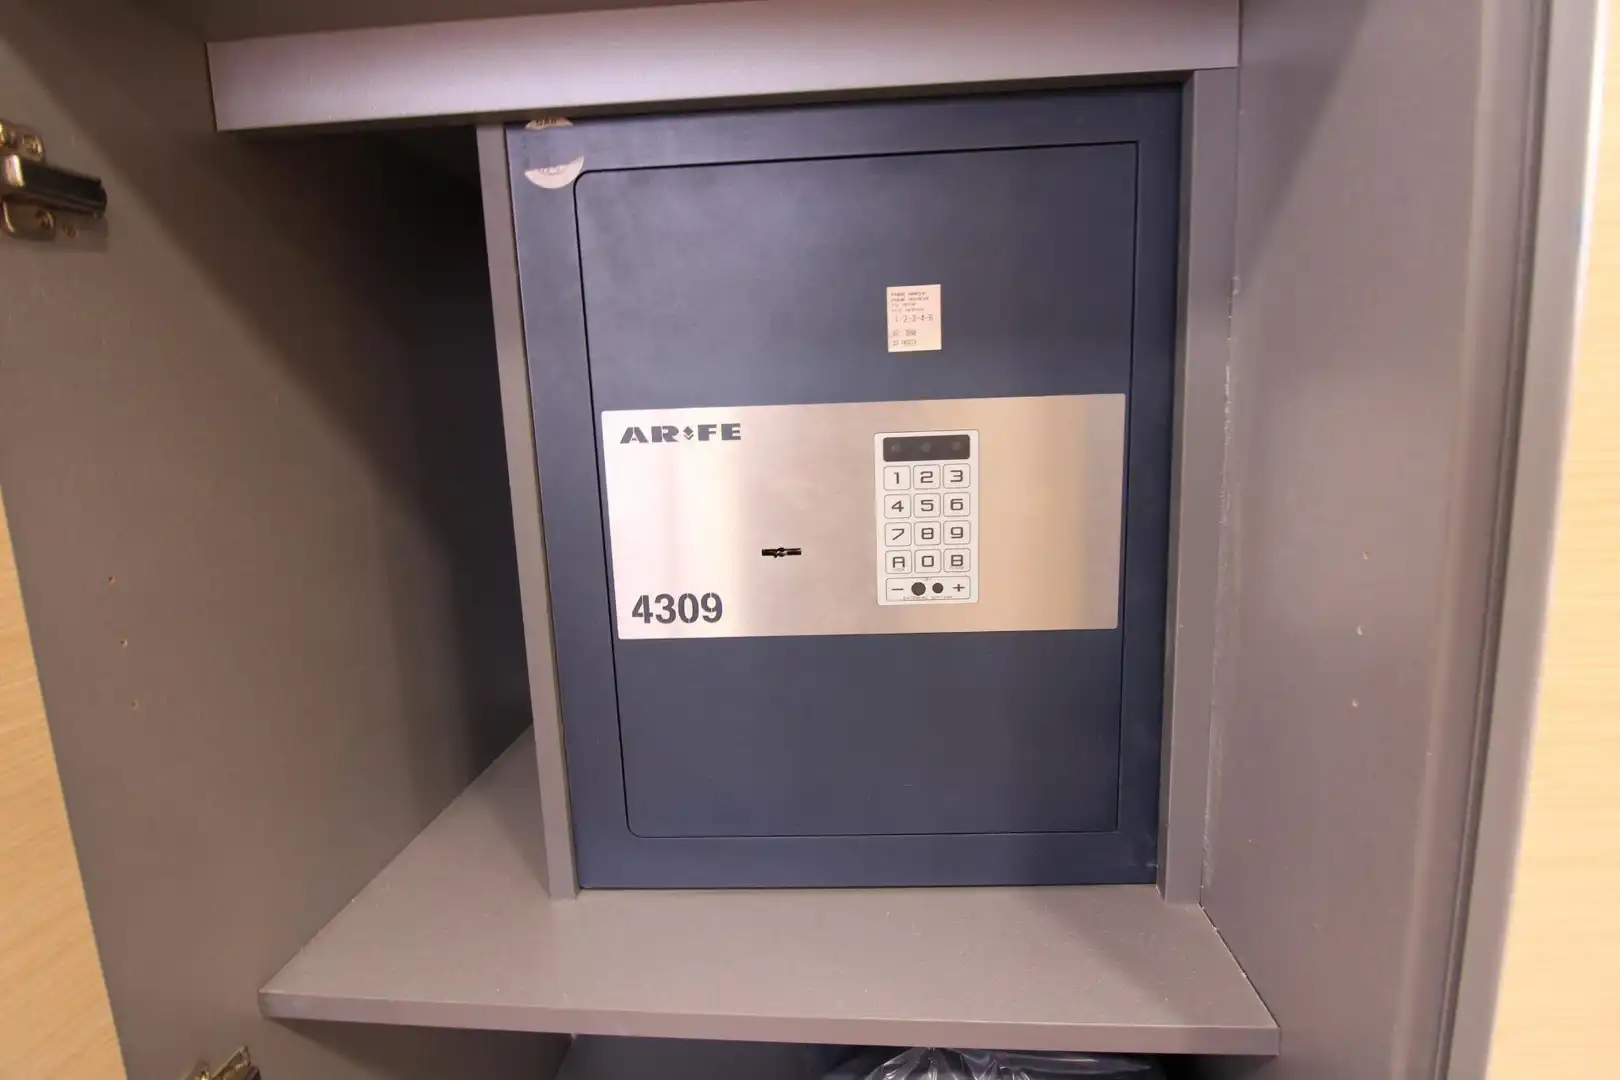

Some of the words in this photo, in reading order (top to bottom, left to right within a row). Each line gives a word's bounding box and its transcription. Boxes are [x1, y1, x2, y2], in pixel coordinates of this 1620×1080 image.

[893, 472, 900, 484] 1
[920, 471, 934, 484] 2
[950, 470, 964, 483] 3
[891, 500, 905, 513] 4
[920, 499, 934, 512] 5
[950, 498, 964, 511] 6
[891, 528, 905, 541] 7
[921, 527, 934, 540] 8
[950, 526, 964, 539] 9
[892, 556, 906, 569] A
[950, 554, 964, 567] B
[631, 592, 723, 625] 4309
